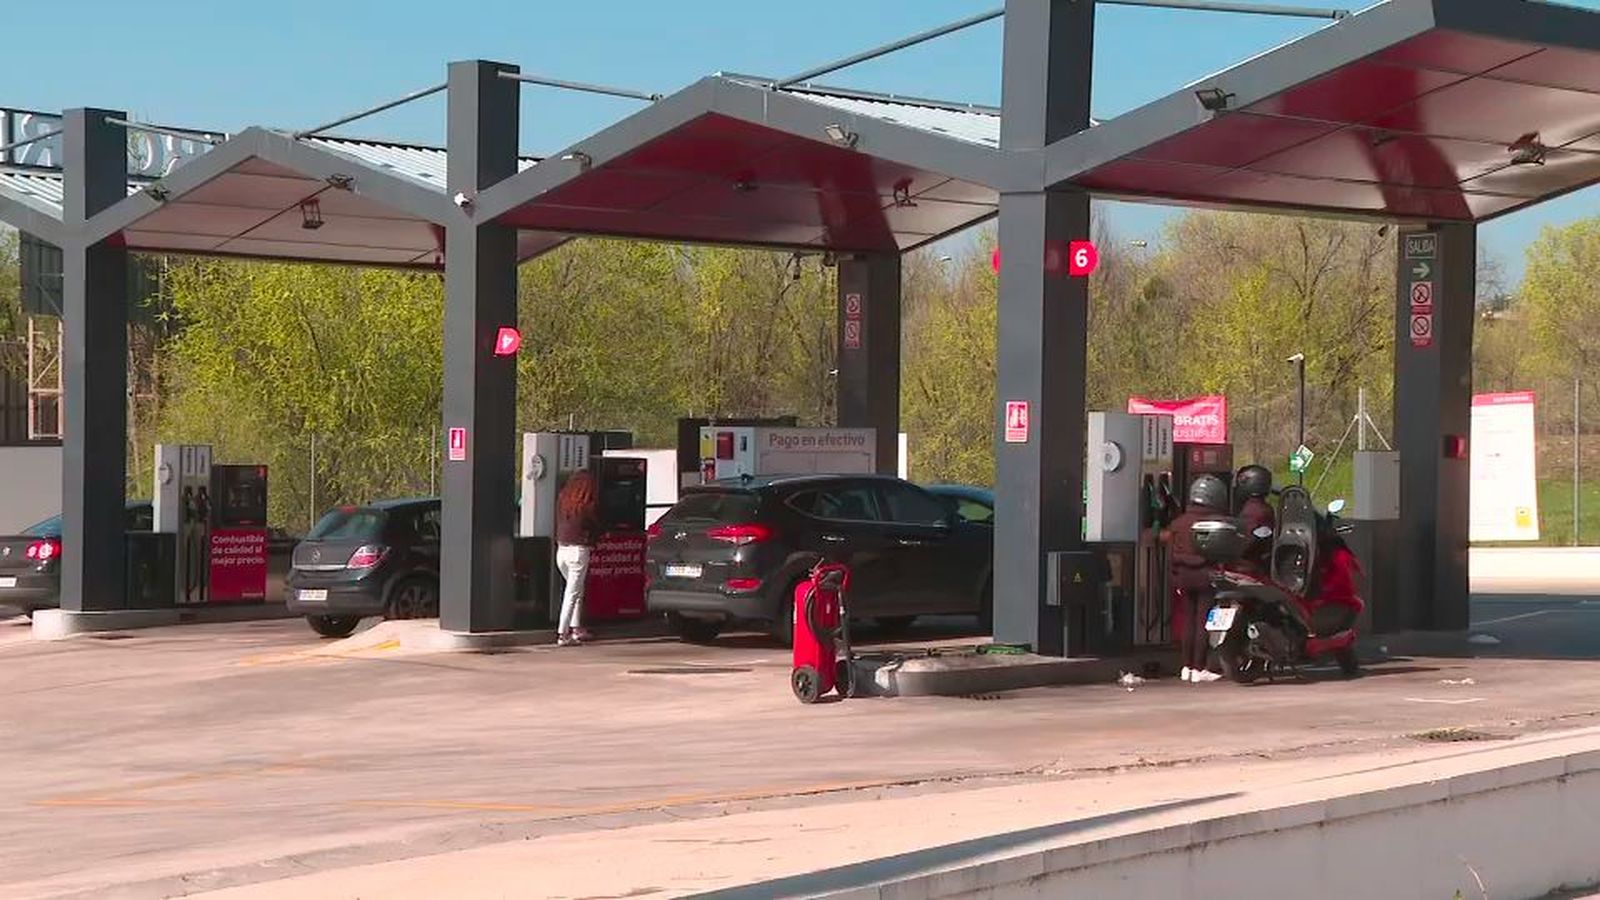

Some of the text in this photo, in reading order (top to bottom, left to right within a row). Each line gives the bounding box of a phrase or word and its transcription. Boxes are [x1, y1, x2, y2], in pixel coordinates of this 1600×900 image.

[1408, 239, 1434, 255] SALIDA
[1075, 248, 1088, 268] 6
[501, 335, 513, 350] 4
[1173, 415, 1218, 426] GRATIS
[769, 433, 865, 448] Pago en efectivo
[212, 534, 264, 544] Combustible
[211, 546, 222, 554] de
[224, 545, 254, 554] calidad
[591, 541, 641, 551] ombustible
[211, 556, 235, 566] mejor
